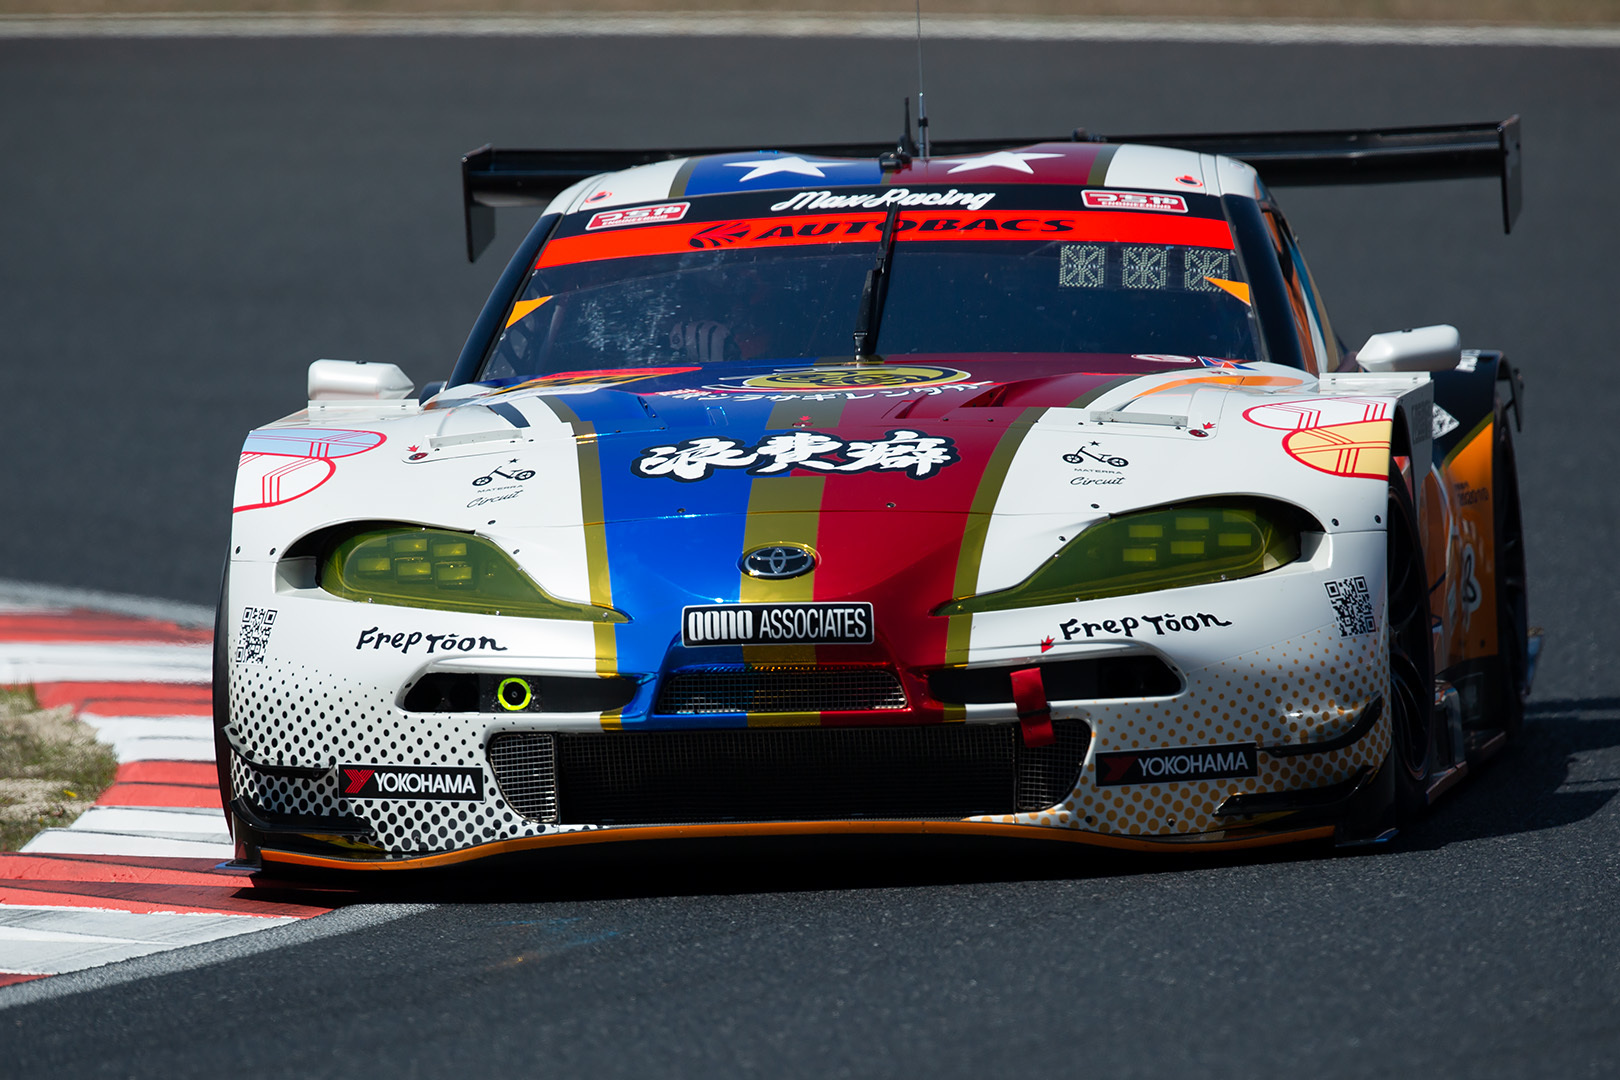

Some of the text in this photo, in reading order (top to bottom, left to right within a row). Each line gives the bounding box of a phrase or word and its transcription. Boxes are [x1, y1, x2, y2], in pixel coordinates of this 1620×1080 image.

[771, 188, 995, 211] Max Racing
[752, 217, 1075, 241] AUTOBACS
[1070, 476, 1126, 486] Circuit
[759, 608, 867, 639] ASSOCIATES
[1138, 751, 1249, 777] YOKOHAMA
[374, 772, 477, 794] YOKOHAMA
